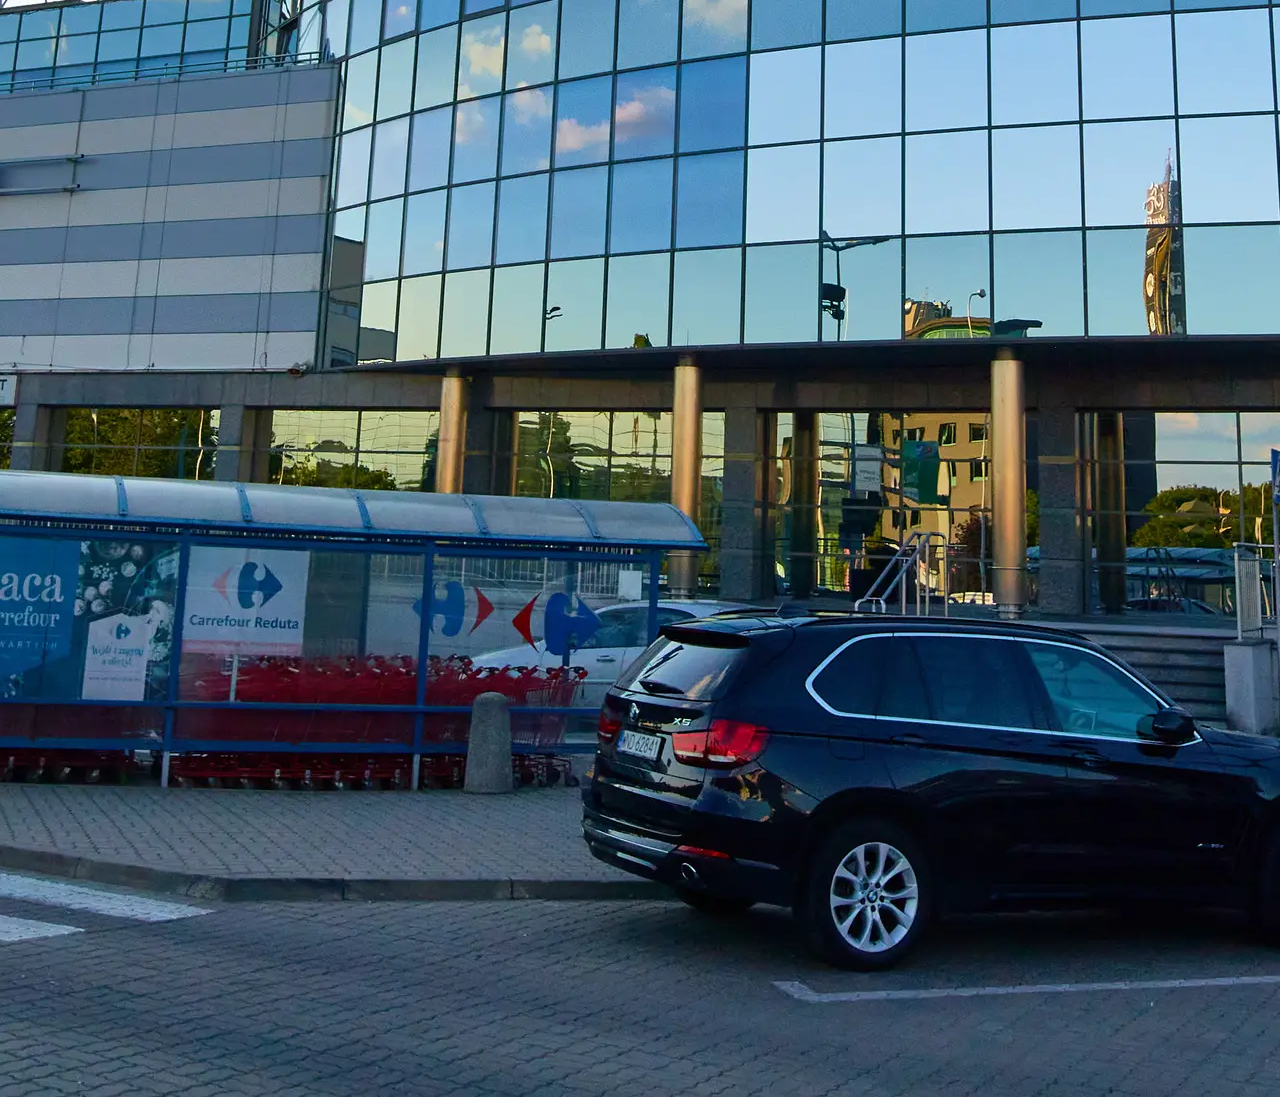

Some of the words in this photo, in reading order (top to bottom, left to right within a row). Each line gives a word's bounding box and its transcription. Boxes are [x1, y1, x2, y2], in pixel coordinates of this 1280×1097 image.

[189, 614, 251, 628] Carrefour
[254, 616, 299, 629] Reduta
[671, 717, 692, 727] X5
